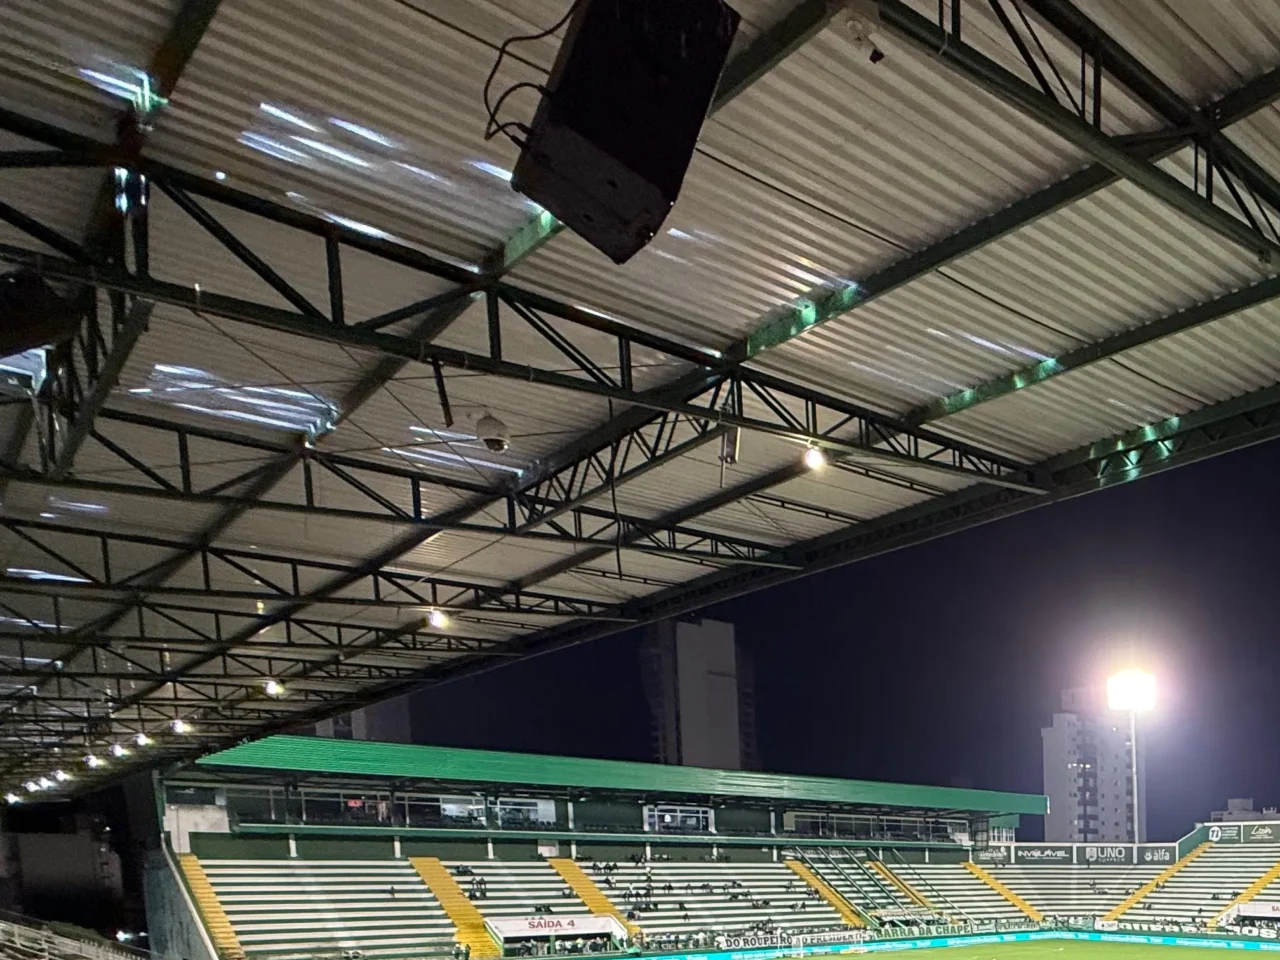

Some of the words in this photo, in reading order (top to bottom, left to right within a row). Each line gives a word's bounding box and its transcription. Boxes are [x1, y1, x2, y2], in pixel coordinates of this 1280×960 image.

[1098, 847, 1125, 858] UNO
[528, 917, 563, 930] SAÍDA
[567, 919, 576, 928] 4
[876, 926, 915, 939] BARRA
[919, 925, 933, 936] DA
[936, 923, 970, 936] CHAPE
[725, 938, 741, 948] DO
